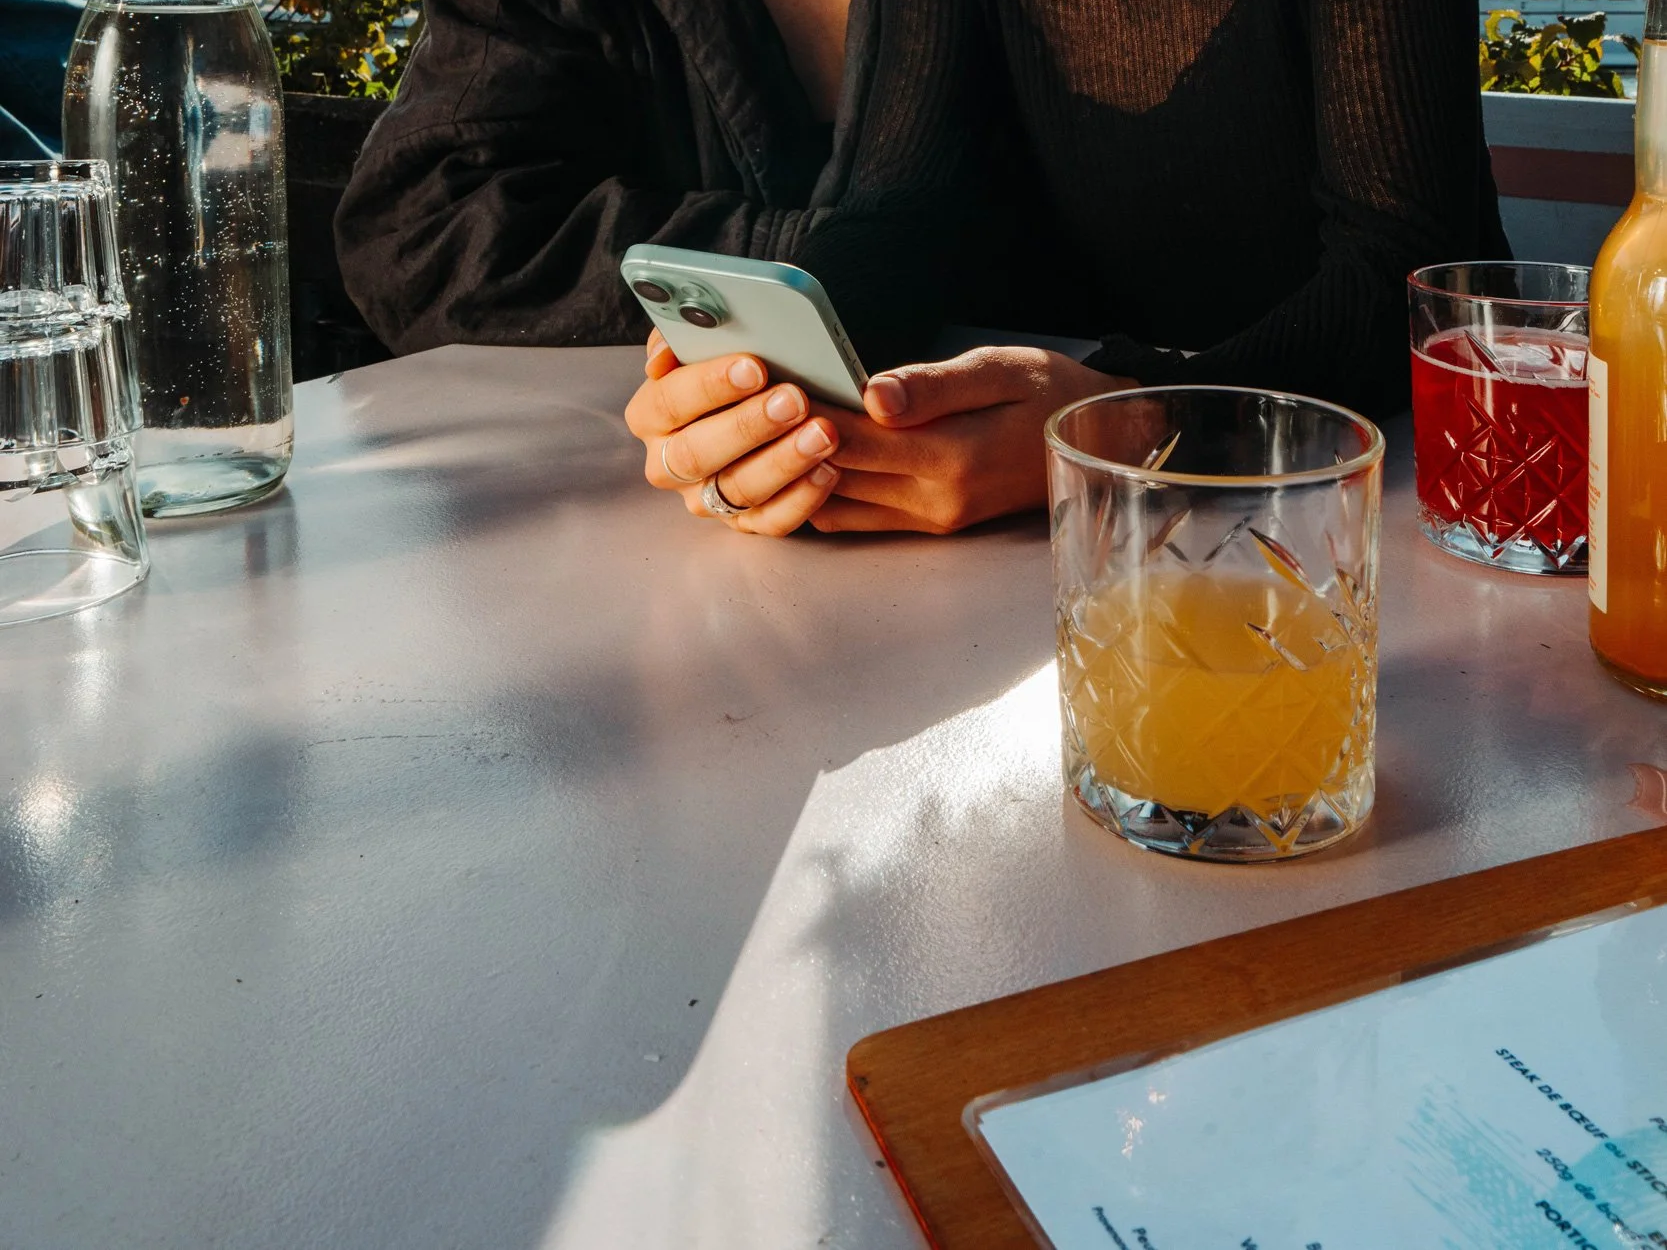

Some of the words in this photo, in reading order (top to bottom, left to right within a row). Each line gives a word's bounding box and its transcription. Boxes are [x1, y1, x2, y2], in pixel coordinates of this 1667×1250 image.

[1495, 1048, 1541, 1083] STEAK
[1537, 1084, 1564, 1101] DE
[1559, 1102, 1609, 1140] BŒUF
[1604, 1141, 1626, 1159] ou
[1536, 1148, 1574, 1182] 250g
[1574, 1182, 1596, 1201] de
